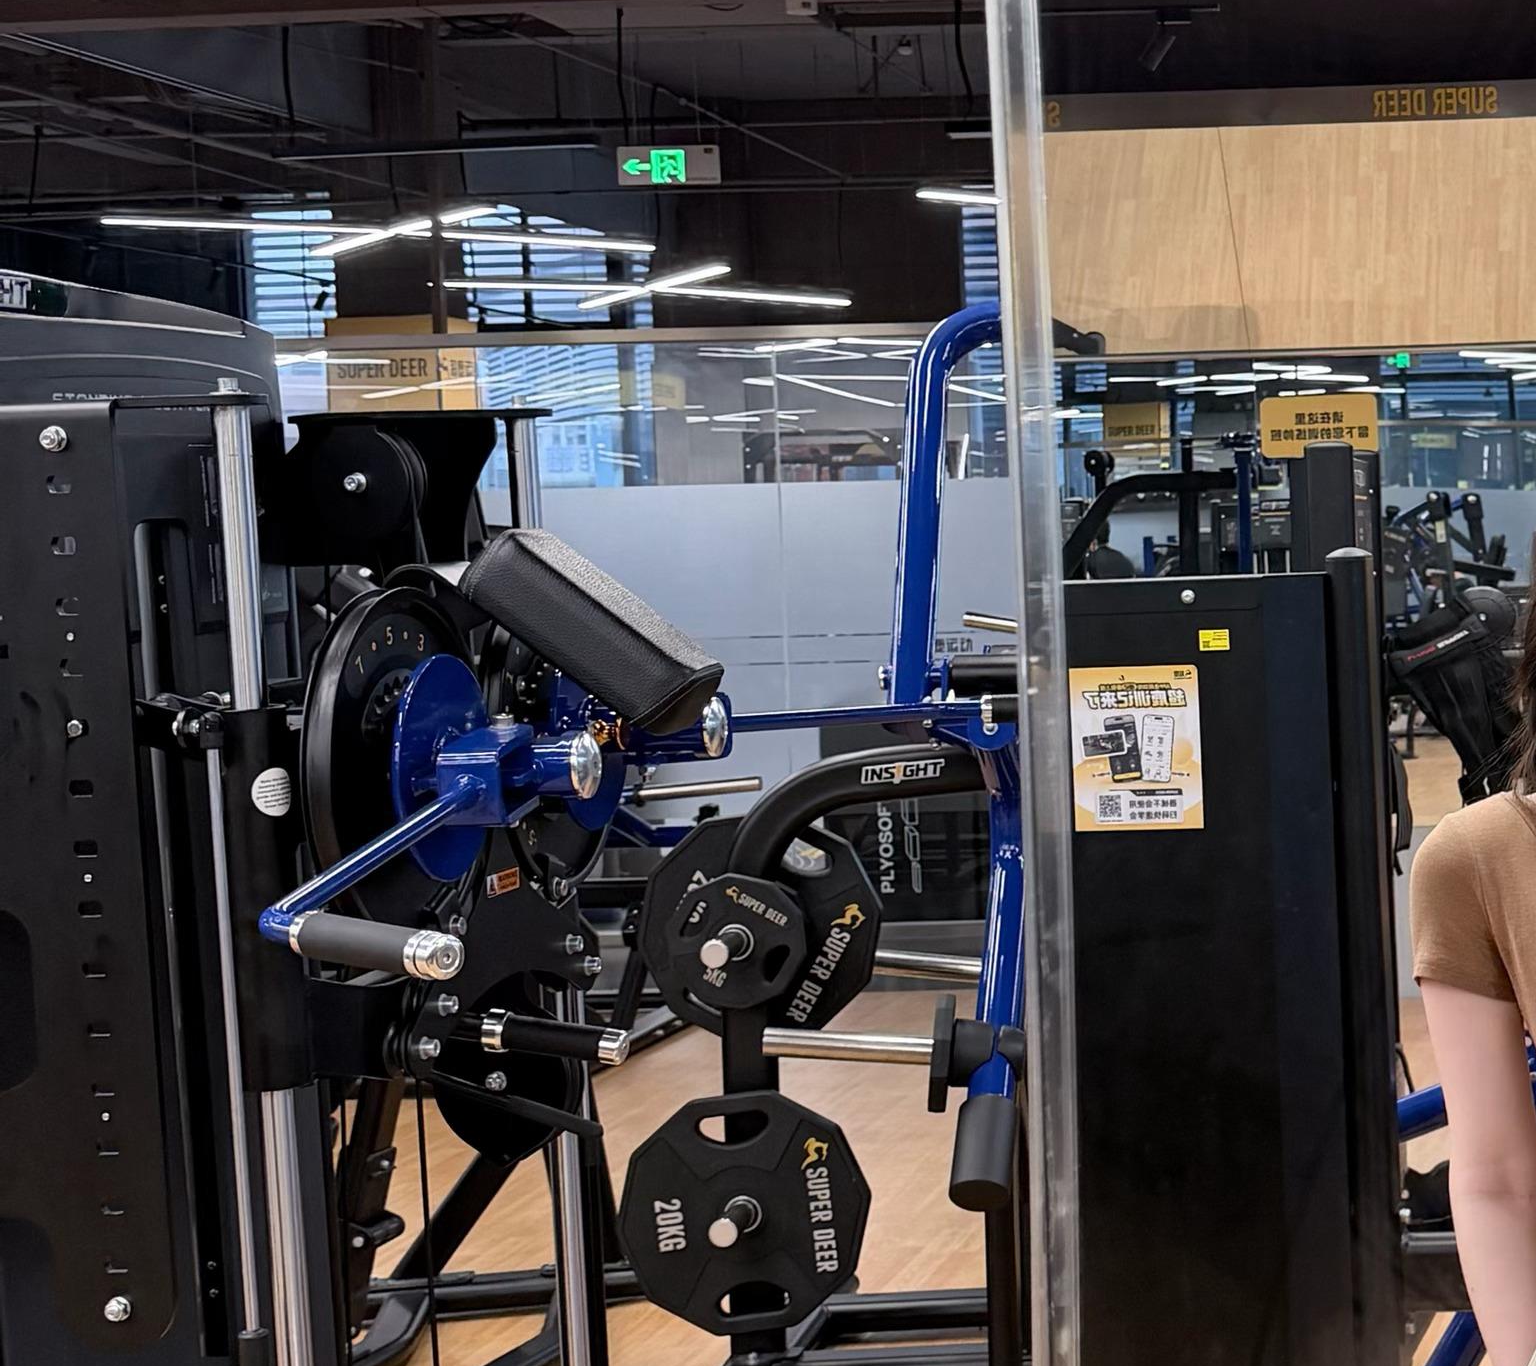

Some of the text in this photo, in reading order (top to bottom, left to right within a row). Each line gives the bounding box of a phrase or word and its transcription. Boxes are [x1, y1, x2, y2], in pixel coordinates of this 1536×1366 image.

[337, 360, 386, 379] SUPER
[389, 358, 428, 377] DEER
[386, 626, 393, 645] 5
[417, 634, 425, 651] 3
[861, 759, 945, 784] INSIGHT
[877, 801, 895, 894] PLYOSOF
[737, 892, 788, 927] SUPER DEER
[702, 967, 728, 988] 5KG
[786, 927, 851, 1023] SUPER DEER
[653, 1198, 687, 1253] 20KG
[806, 1166, 839, 1273] SUPER DEER
